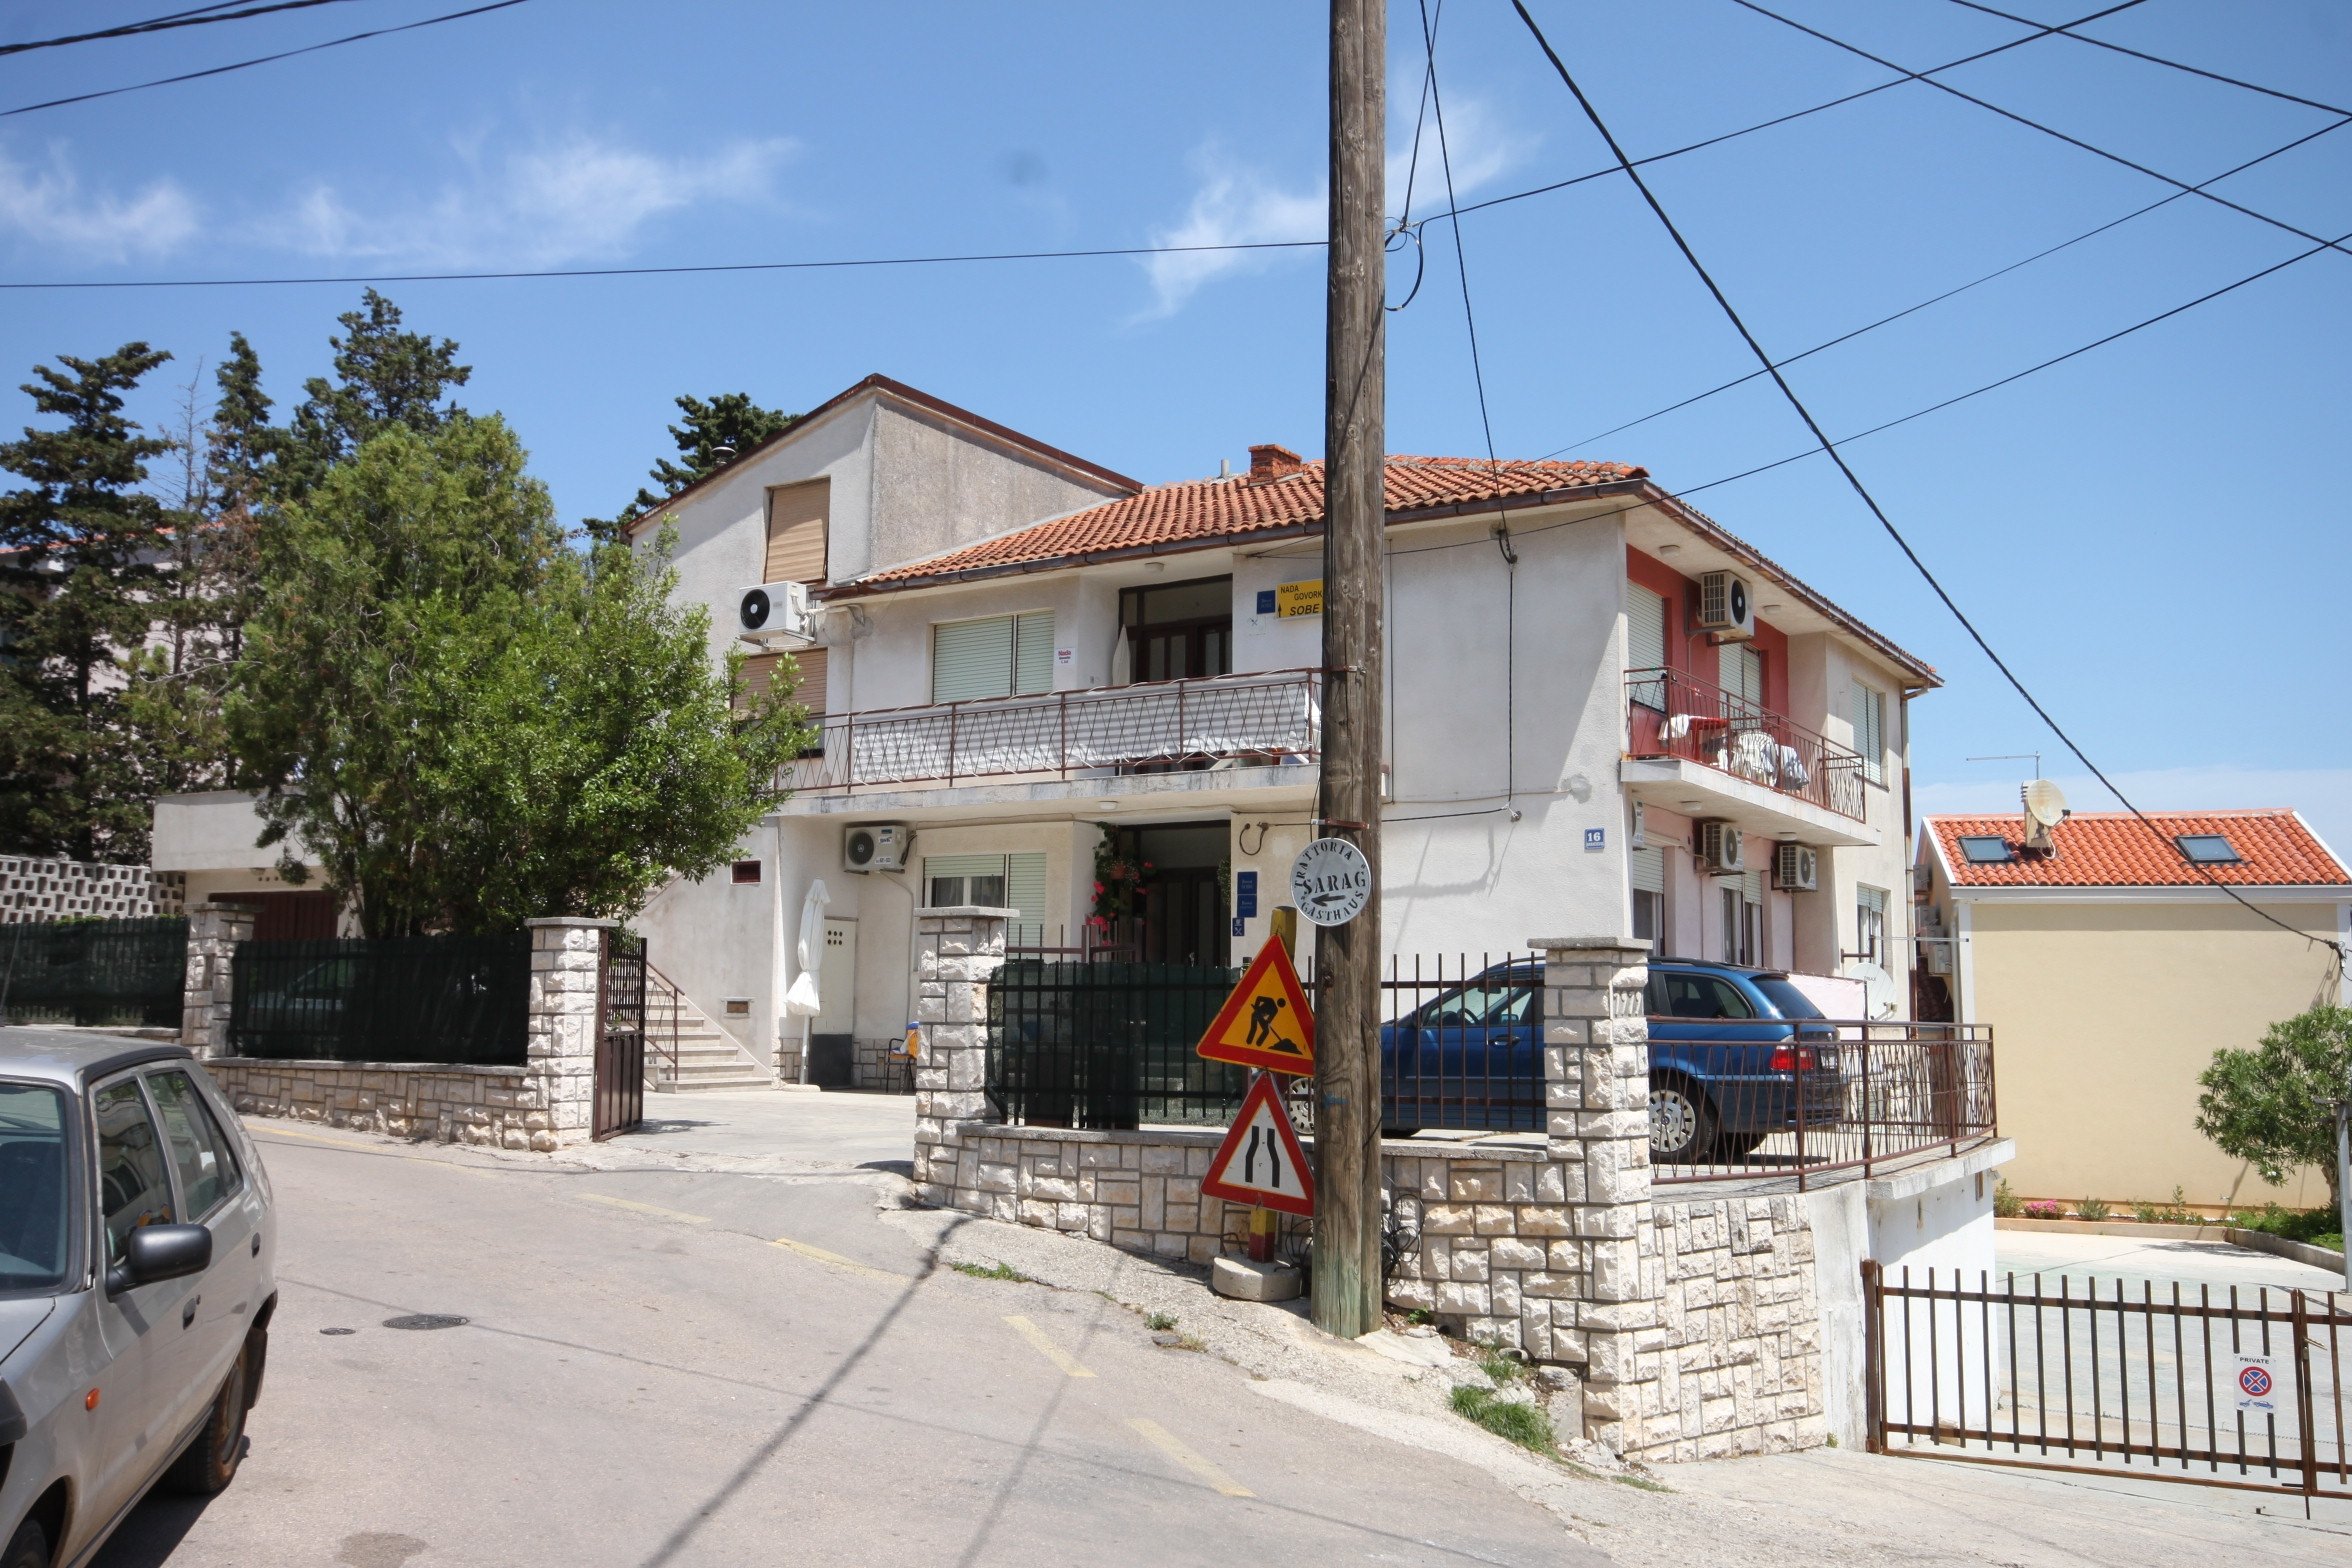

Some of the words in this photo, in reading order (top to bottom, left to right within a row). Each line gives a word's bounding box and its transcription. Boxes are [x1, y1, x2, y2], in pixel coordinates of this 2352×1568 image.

[1280, 585, 1299, 594] NADA
[1290, 603, 1320, 616] SOBE
[1587, 831, 1601, 842] 16
[1294, 841, 1352, 888] TRATTORIA
[1301, 890, 1364, 921] GASTHAUS
[2239, 1356, 2270, 1365] PRIVATE
